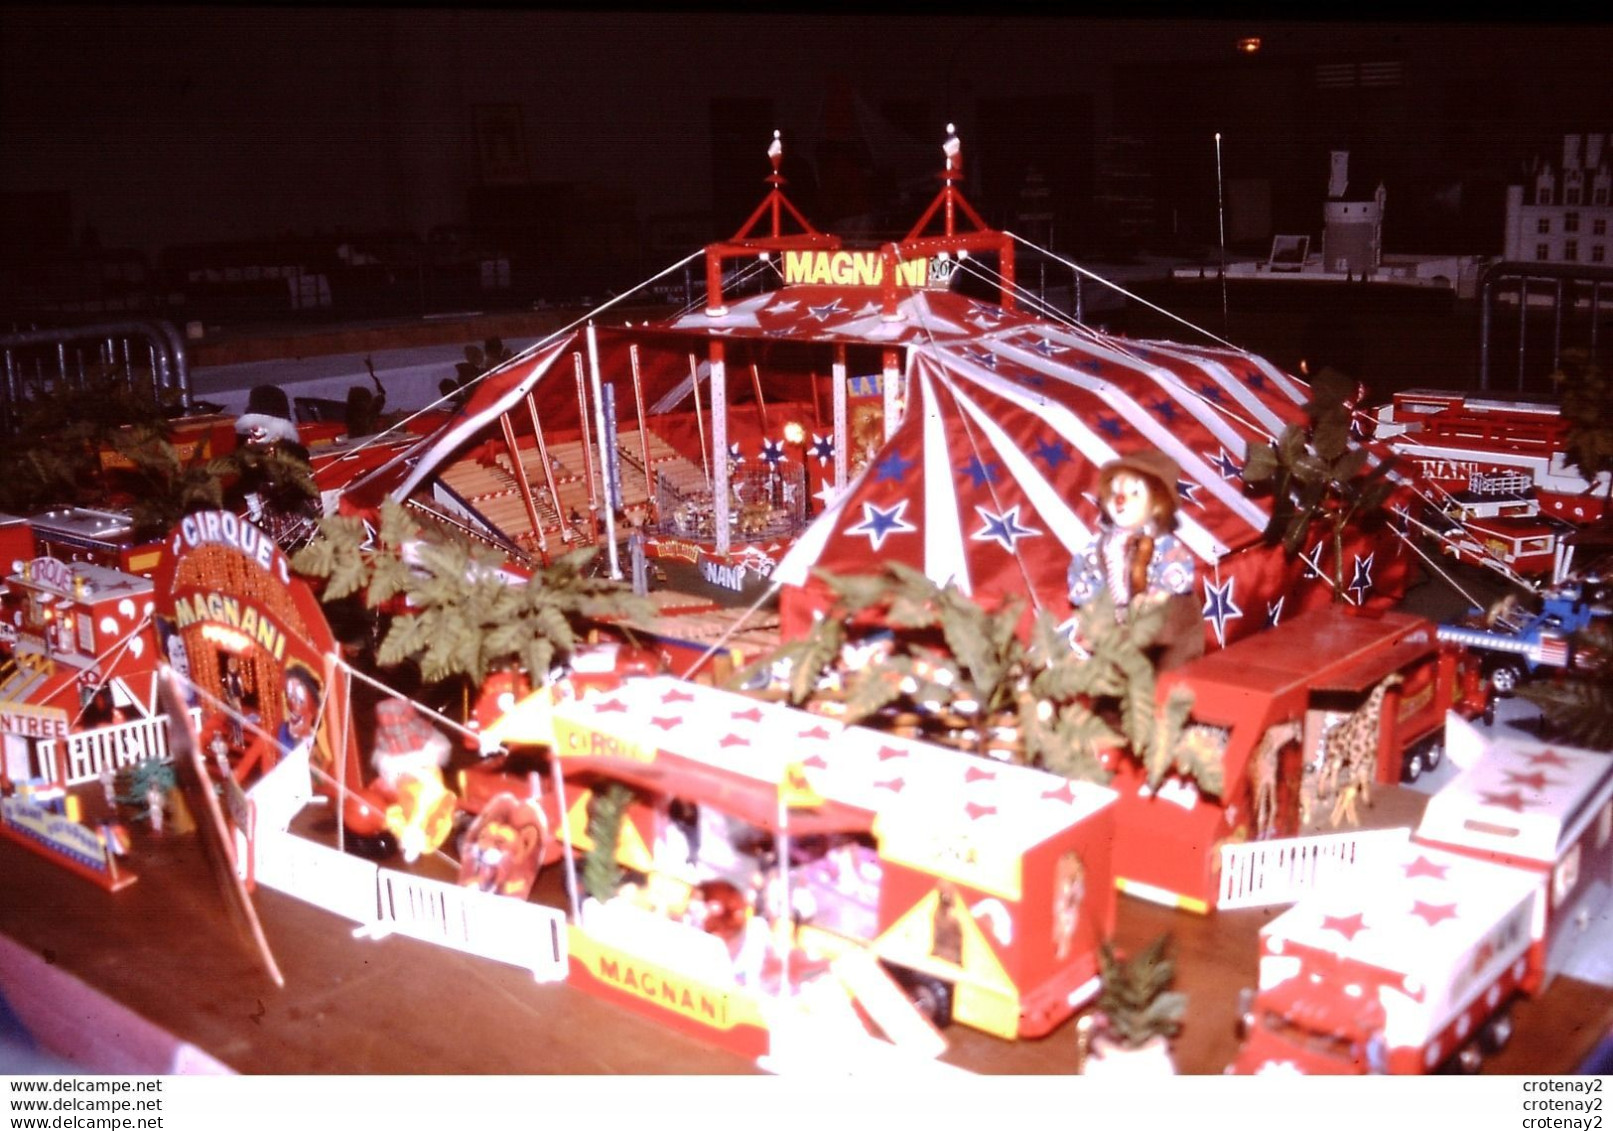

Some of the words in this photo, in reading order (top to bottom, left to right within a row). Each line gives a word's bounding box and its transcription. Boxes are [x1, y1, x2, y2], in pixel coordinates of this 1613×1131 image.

[181, 509, 274, 572] CIRQUE
[174, 591, 287, 662] MAGNANI
[568, 731, 642, 759] CIRQ
[599, 956, 728, 1025] MAGNANI
